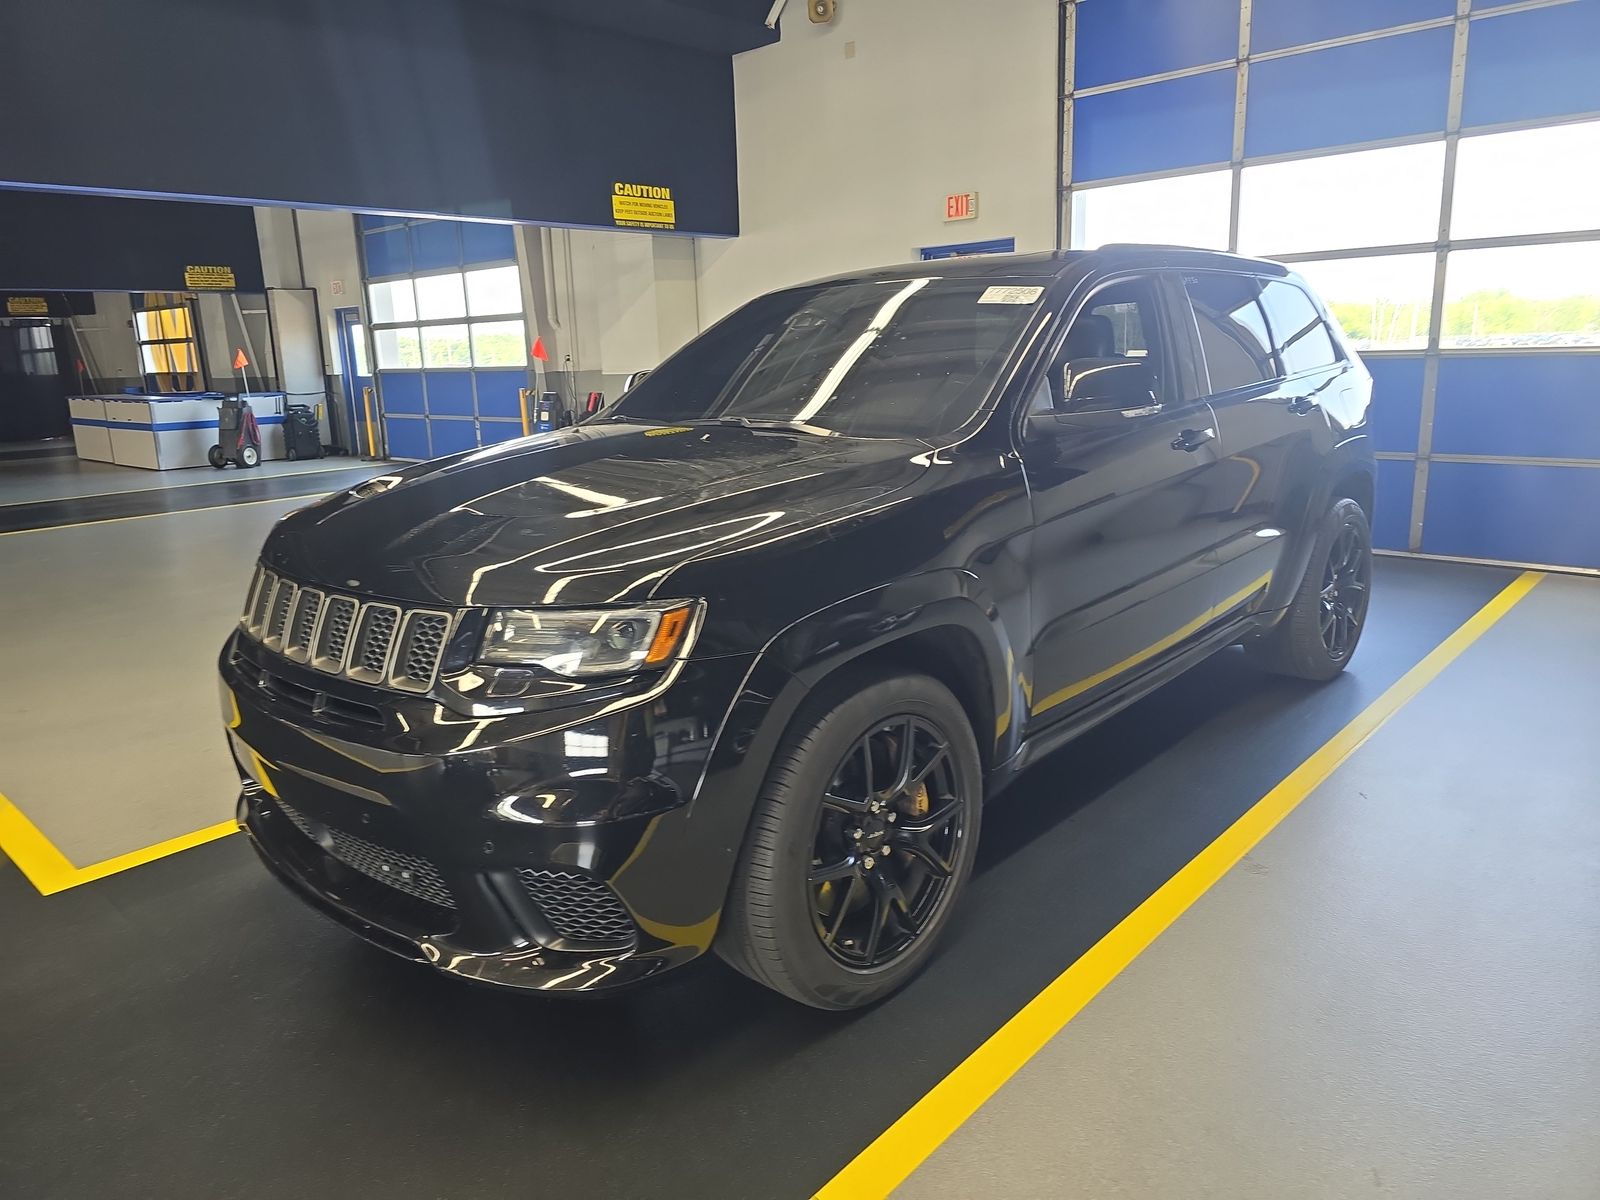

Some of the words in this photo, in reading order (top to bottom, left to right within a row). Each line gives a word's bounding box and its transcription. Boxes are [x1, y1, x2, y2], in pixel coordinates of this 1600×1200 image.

[614, 182, 671, 200] CAUTION
[947, 194, 970, 217] EXIT
[186, 265, 231, 274] CAUTION
